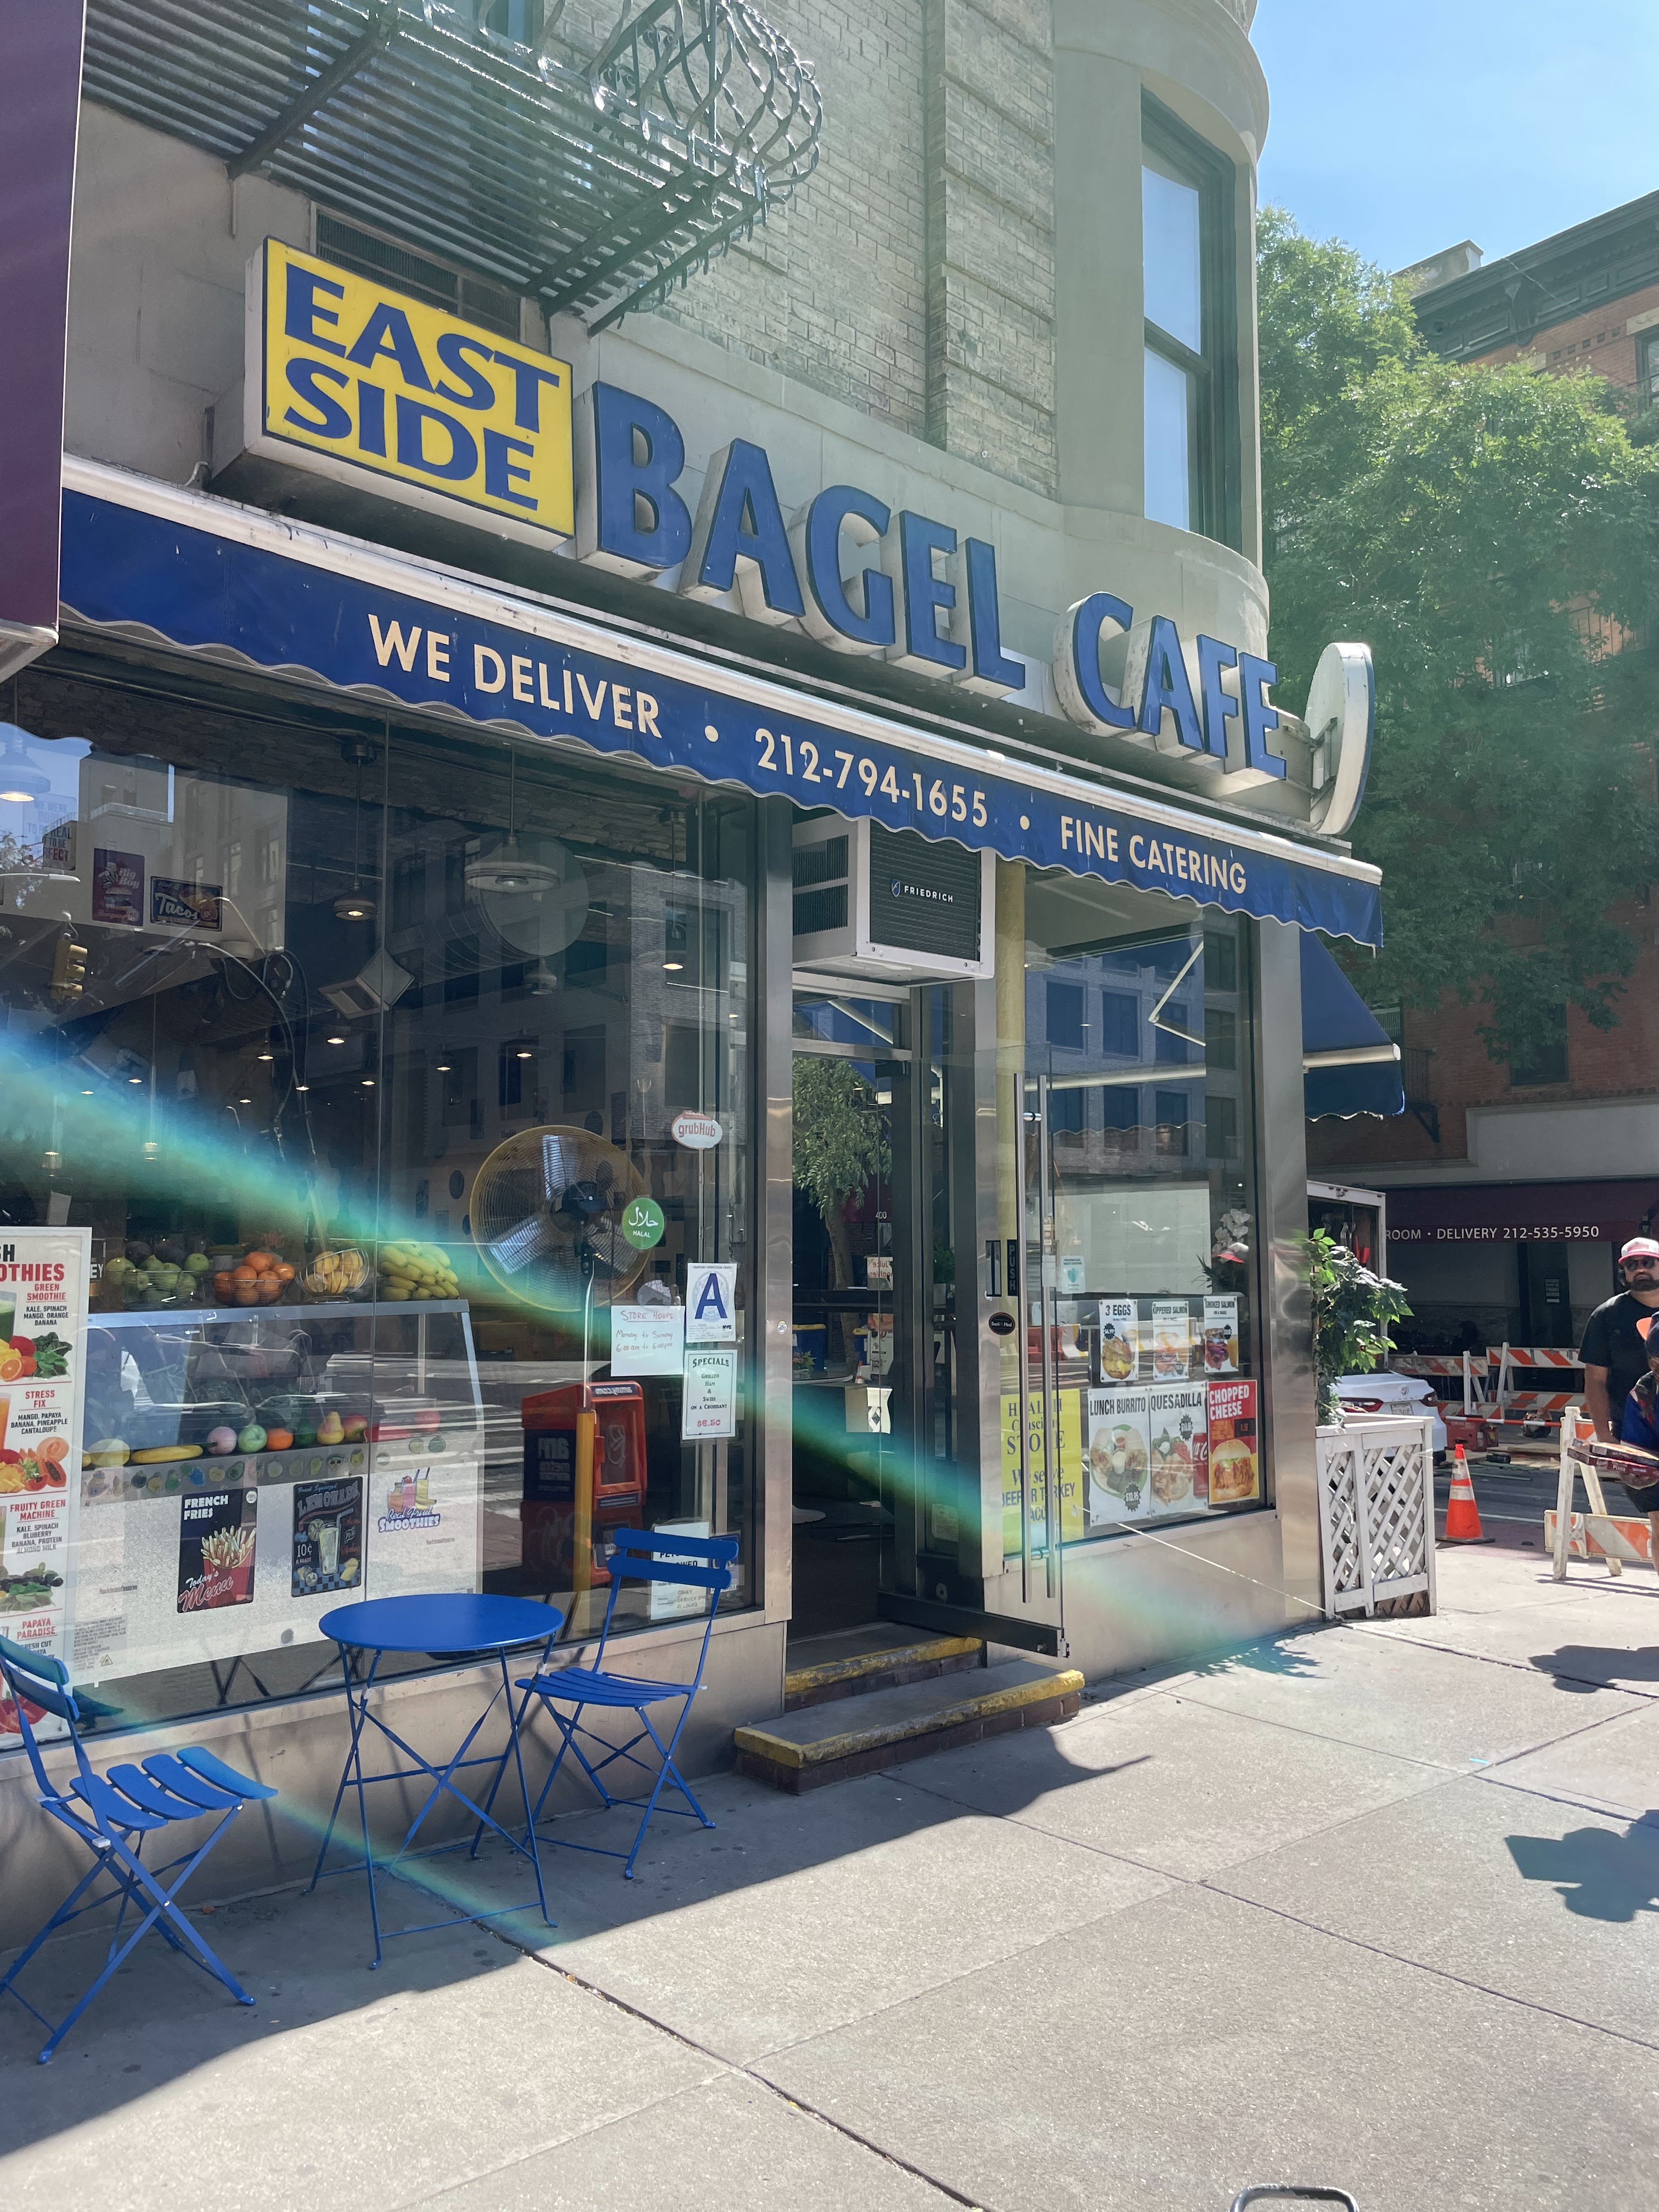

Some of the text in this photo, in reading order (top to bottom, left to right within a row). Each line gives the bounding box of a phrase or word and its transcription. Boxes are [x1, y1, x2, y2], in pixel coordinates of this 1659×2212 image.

[285, 262, 560, 433] EAST
[284, 358, 539, 511] SIDE
[592, 380, 1287, 781] BAGEL CAFE
[368, 613, 1247, 894] WE DELIVER 212-794-1655 FINE CATERING
[119, 867, 137, 879] Big
[119, 877, 140, 889] Boy
[904, 885, 953, 903] FRIEDRICH
[154, 892, 198, 920] Tacos
[678, 1122, 716, 1137] grubHub
[628, 1206, 658, 1227] حلال
[875, 1211, 887, 1220] 400
[633, 1230, 651, 1238] HALAL
[1437, 1227, 1497, 1239] DELIVERY
[1503, 1226, 1599, 1239] 212-535-5950
[0, 1244, 15, 1262] H
[35, 1283, 60, 1291] GREEN
[27, 1292, 66, 1301] SMOOTHIE
[695, 1273, 728, 1319] A
[620, 1310, 673, 1321] STORE HOURS
[1105, 1304, 1131, 1316] 3 EGGS
[616, 1329, 637, 1340] Monday
[652, 1330, 673, 1341] Sunday
[692, 1357, 729, 1368] SPECIALS
[25, 1390, 55, 1400] STRESS
[1209, 1384, 1250, 1405] CHOPPED
[33, 1400, 46, 1408] FIX
[1008, 1398, 1063, 1417] HALH
[1090, 1397, 1146, 1416] LUNCH BURRITO
[1151, 1392, 1202, 1412] QUESADILLA
[1210, 1401, 1243, 1420] CHEESE
[37, 1418, 68, 1426] PINEAPPLE
[697, 1419, 721, 1427] $6.50
[21, 1426, 57, 1434] CANTALOUPE
[1007, 1430, 1065, 1455] SOE
[184, 1494, 229, 1509] FRENCH
[297, 1480, 358, 1519] LEMONADE
[1126, 1491, 1139, 1502] $10.95
[10, 1499, 66, 1513] FRUITY GREEN
[386, 1505, 433, 1519] Real Fruit
[20, 1510, 55, 1521] MACHINE
[184, 1508, 213, 1520] FRIES
[34, 1522, 59, 1531] SPINACH
[379, 1515, 441, 1532] SMOOTHIES
[23, 1530, 52, 1539] BLUBERRY
[38, 1536, 63, 1544] PROTEIN
[16, 1543, 57, 1555] ALMOND MILK
[297, 1543, 313, 1558] 10¢
[185, 1568, 219, 1588] Today's
[178, 1576, 234, 1612] Menu
[22, 1617, 51, 1629] PAPAYA
[16, 1626, 56, 1640] PARADISE
